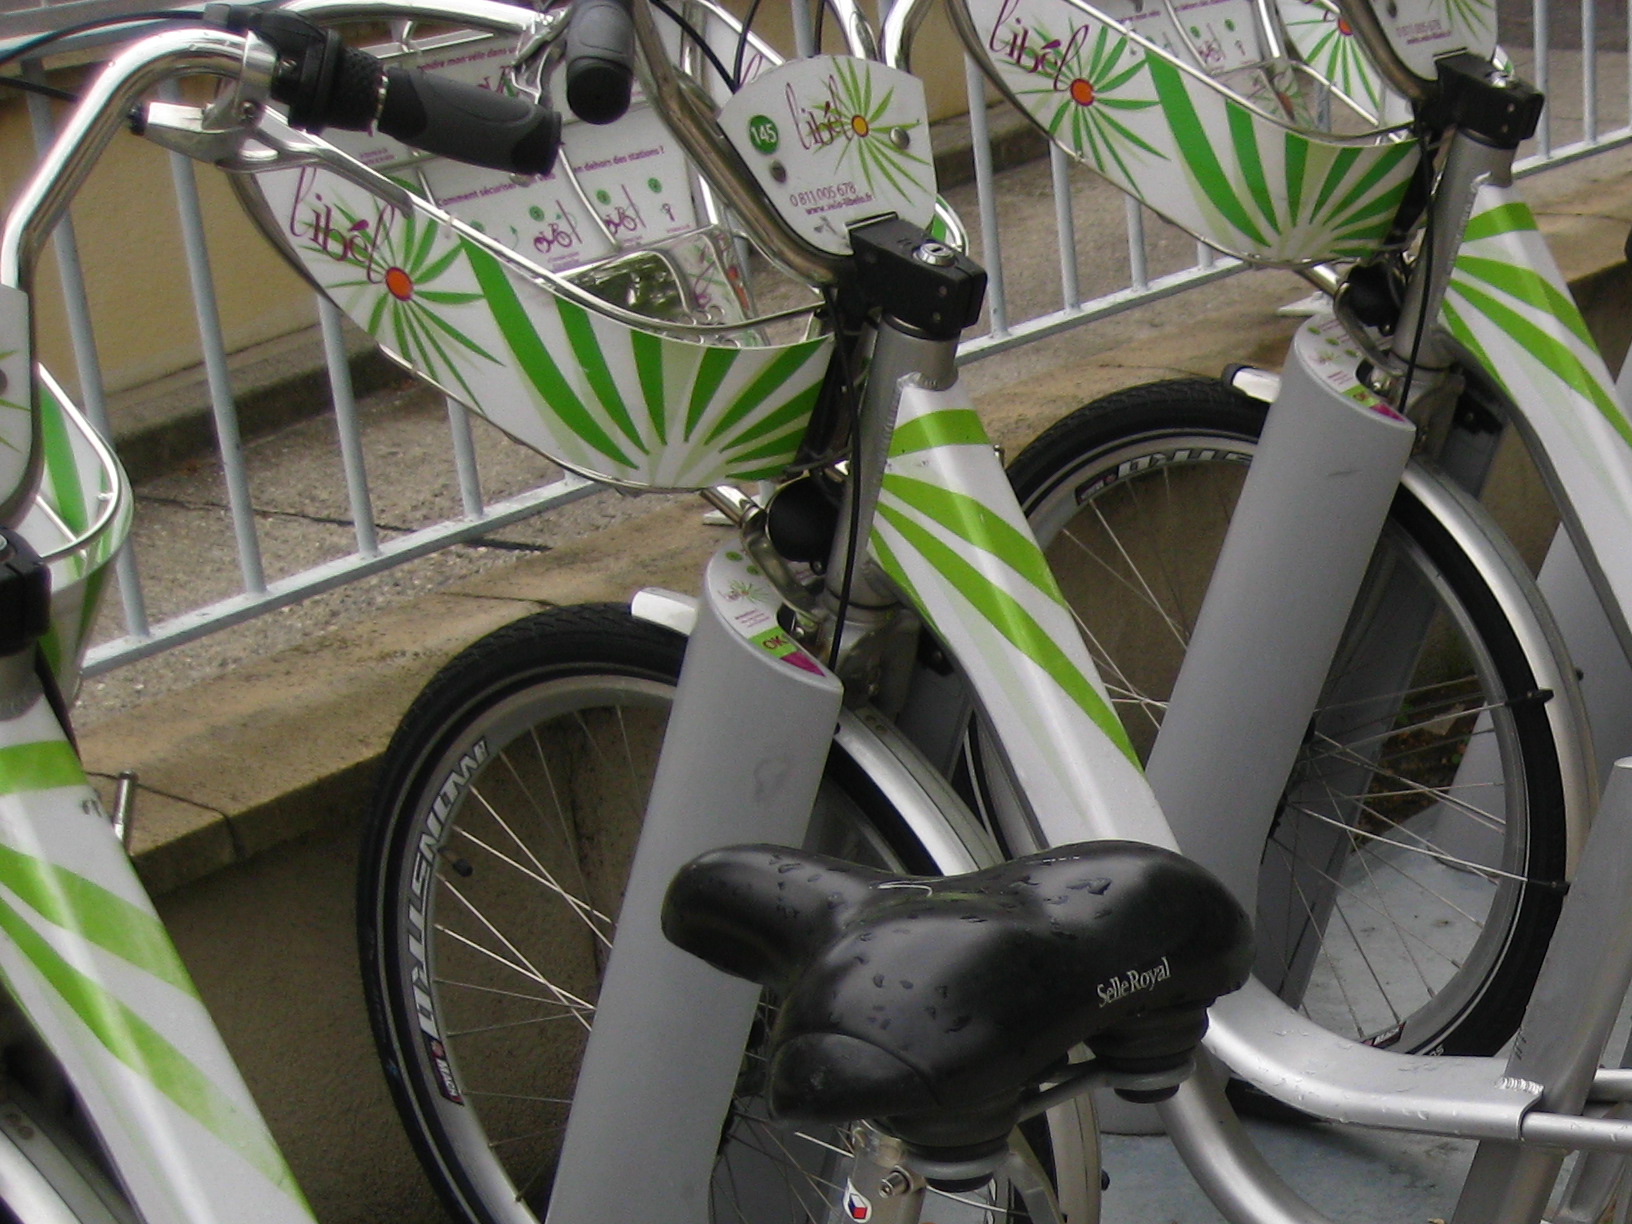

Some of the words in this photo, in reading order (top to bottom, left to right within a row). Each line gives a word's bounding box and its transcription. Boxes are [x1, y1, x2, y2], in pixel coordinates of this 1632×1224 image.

[750, 122, 777, 145] 145
[1095, 976, 1130, 1009] Selle
[1128, 956, 1171, 996] Royal
